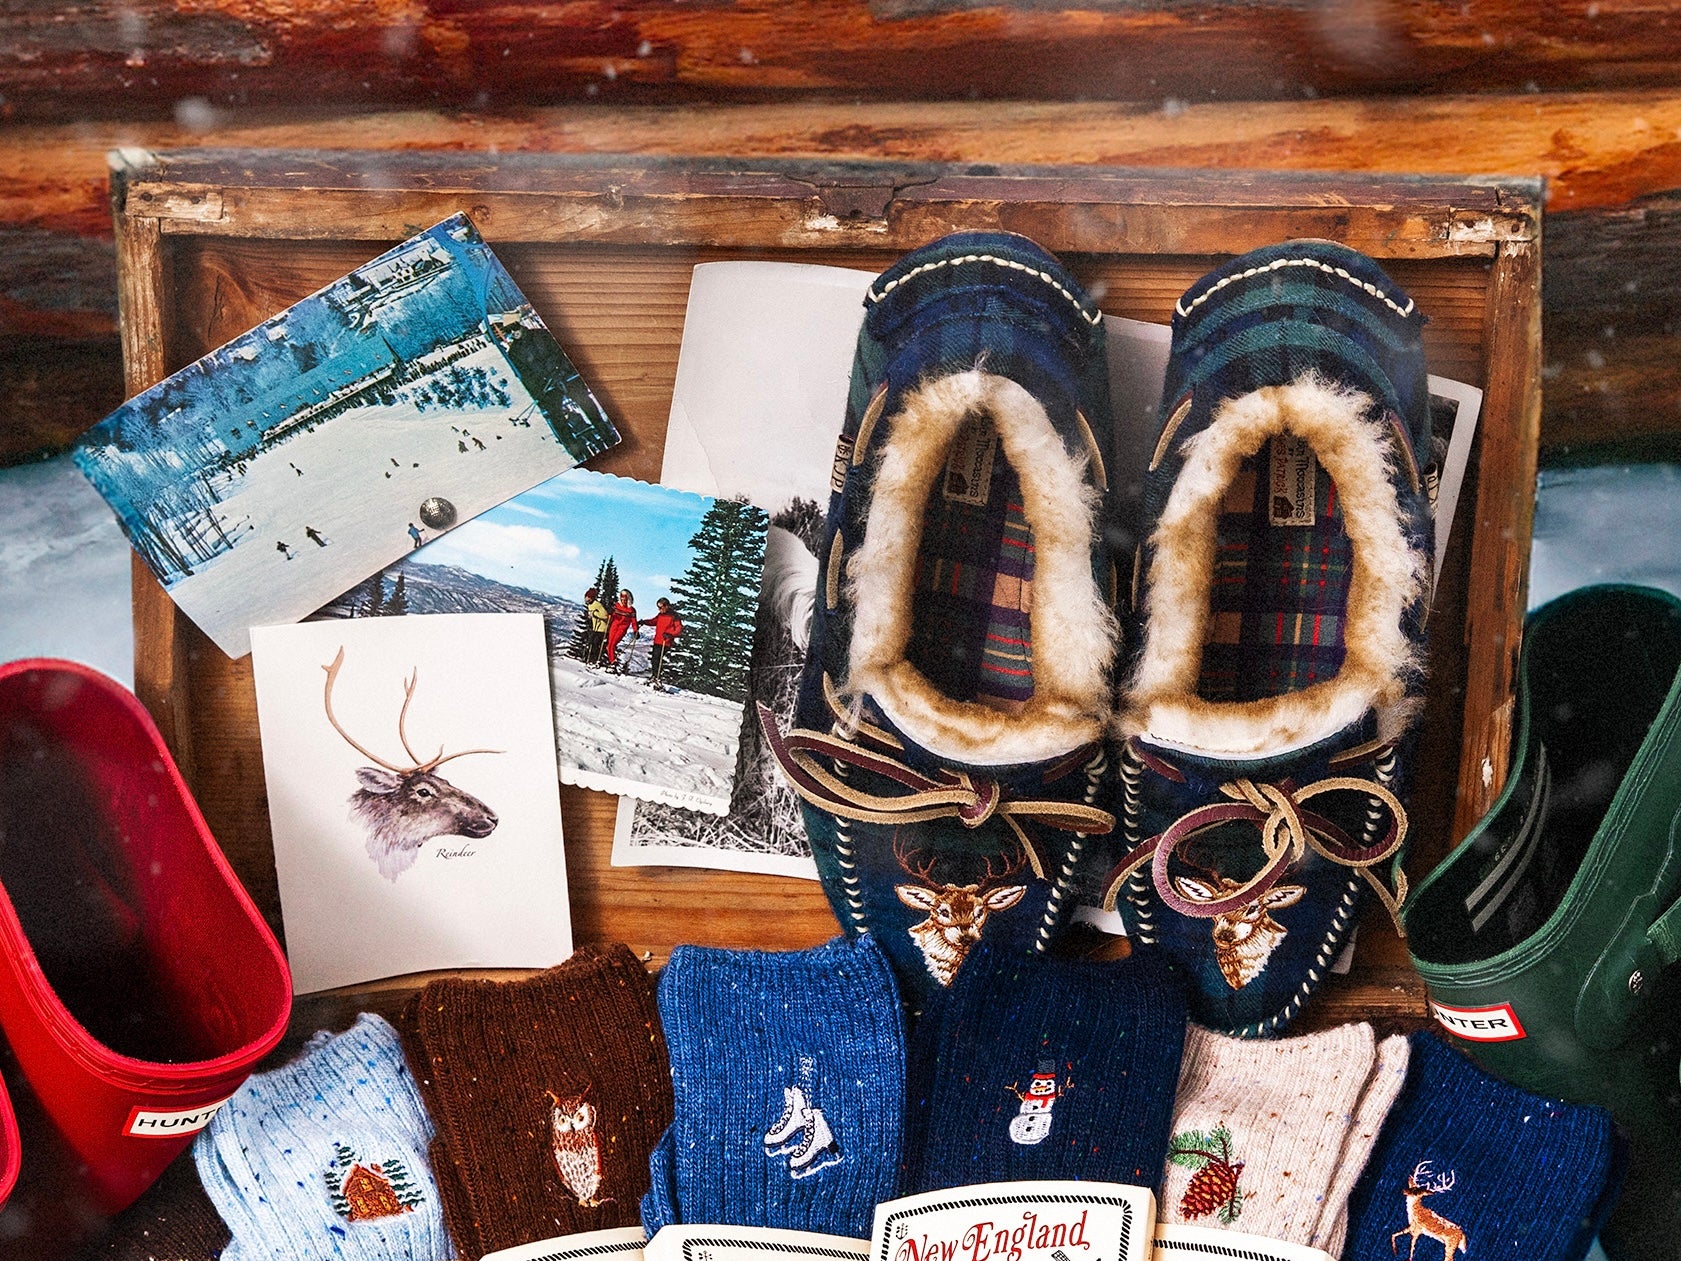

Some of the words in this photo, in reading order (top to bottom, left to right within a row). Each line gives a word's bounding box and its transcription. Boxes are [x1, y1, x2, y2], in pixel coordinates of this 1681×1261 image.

[1295, 457, 1309, 519] Moccasins
[435, 844, 477, 859] Reindeer
[1434, 1007, 1509, 1030] NTER
[138, 1106, 223, 1128] HUNT
